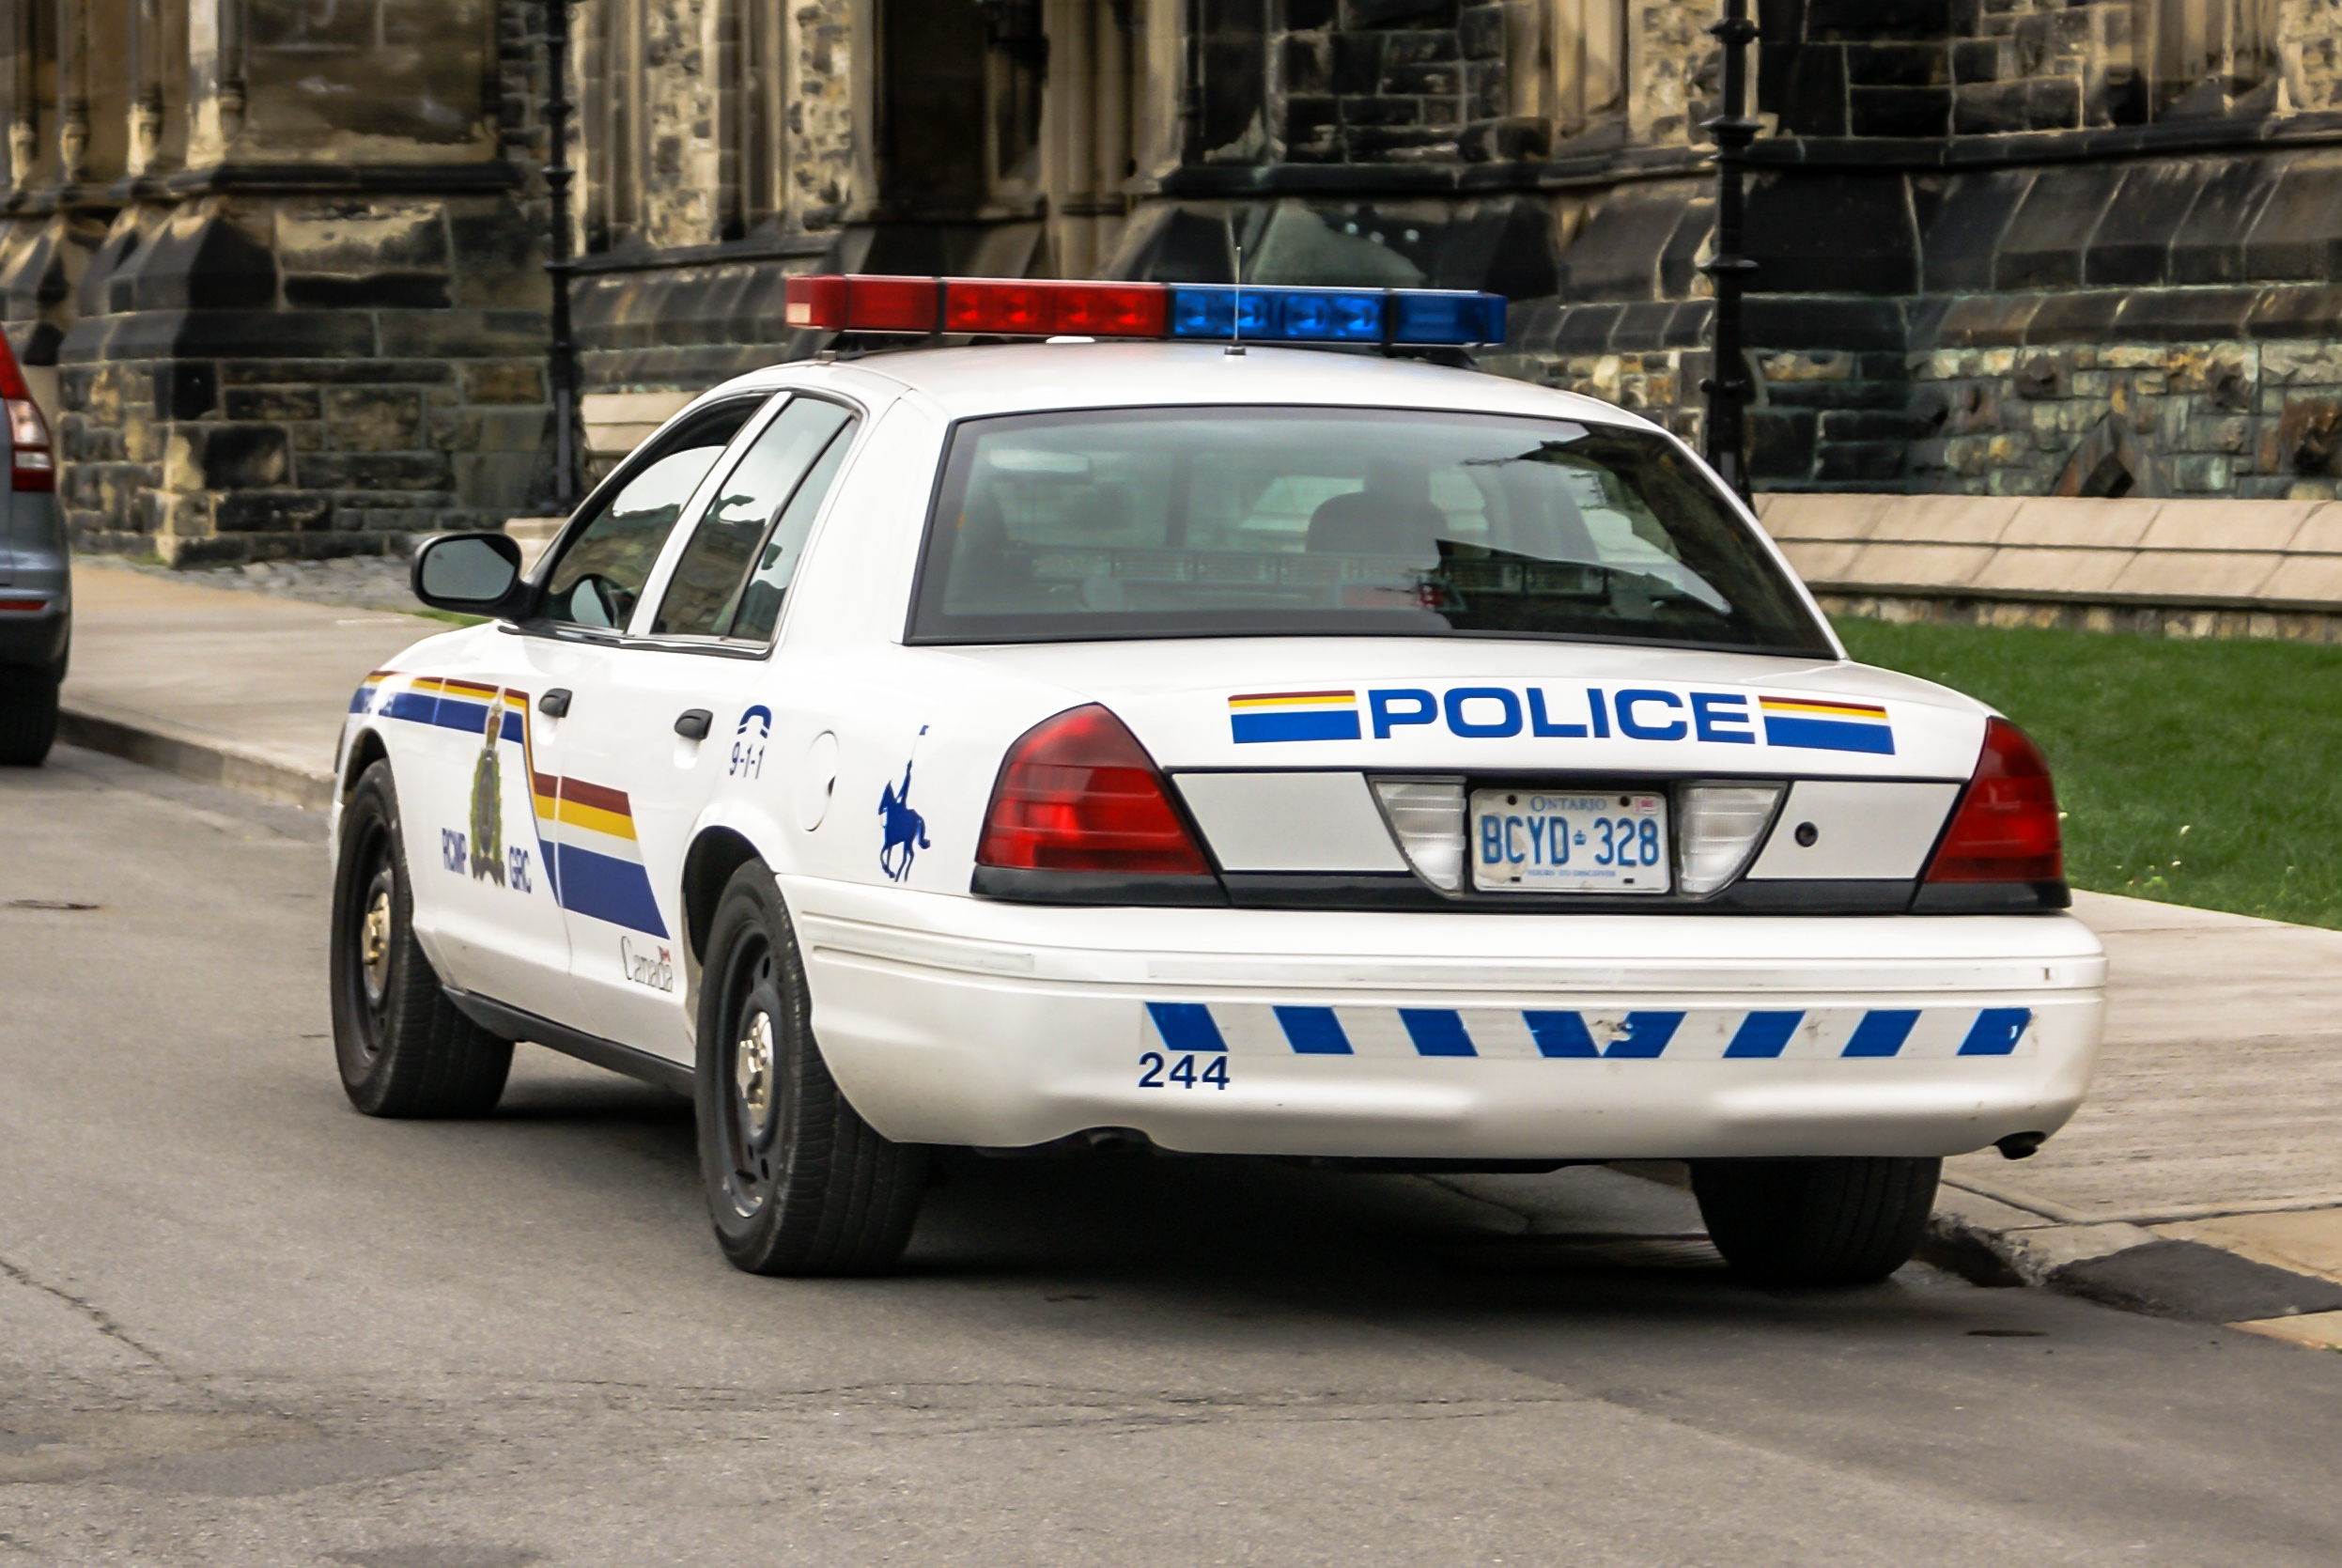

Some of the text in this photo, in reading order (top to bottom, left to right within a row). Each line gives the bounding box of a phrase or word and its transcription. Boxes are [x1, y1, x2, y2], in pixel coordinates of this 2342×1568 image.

[1367, 686, 1757, 745] POLICE
[729, 740, 766, 781] 9-1-1
[1529, 795, 1607, 813] ONTARIO
[1480, 814, 1660, 867] BCYD 328
[509, 845, 532, 894] GRC
[621, 935, 674, 994] Canada
[1138, 1050, 1231, 1091] 244
